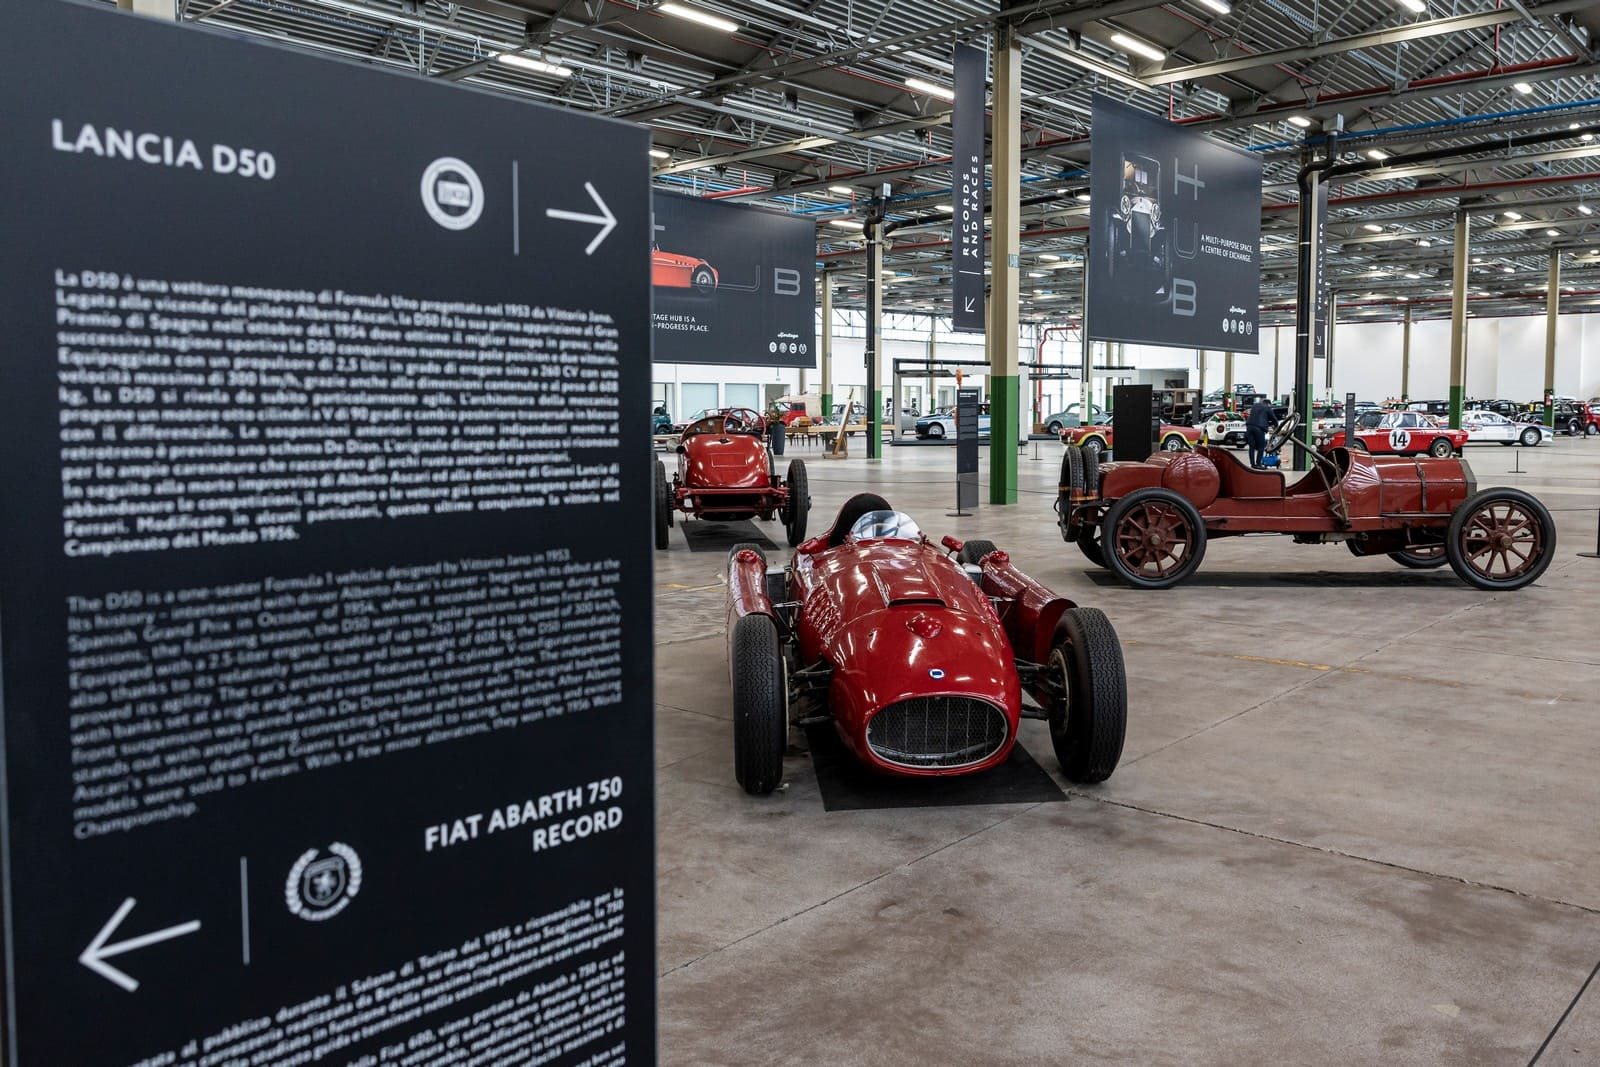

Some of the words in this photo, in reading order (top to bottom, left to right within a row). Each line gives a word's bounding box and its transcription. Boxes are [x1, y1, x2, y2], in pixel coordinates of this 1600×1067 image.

[52, 118, 204, 170] LANCIA
[212, 143, 276, 180] D50
[962, 173, 970, 256] RECORDS
[1200, 244, 1204, 252] A
[1205, 246, 1221, 256] CENTRE
[1222, 250, 1228, 258] OF
[1229, 251, 1252, 262] EXCHANGE.
[1205, 235, 1240, 250] MULTI-PURPOSE
[1240, 244, 1253, 254] SPACE,
[1392, 431, 1407, 446] 14
[425, 813, 482, 851] FIAT
[487, 786, 583, 834] ABARTH
[587, 776, 623, 804] 750
[532, 806, 624, 852] RECORD
